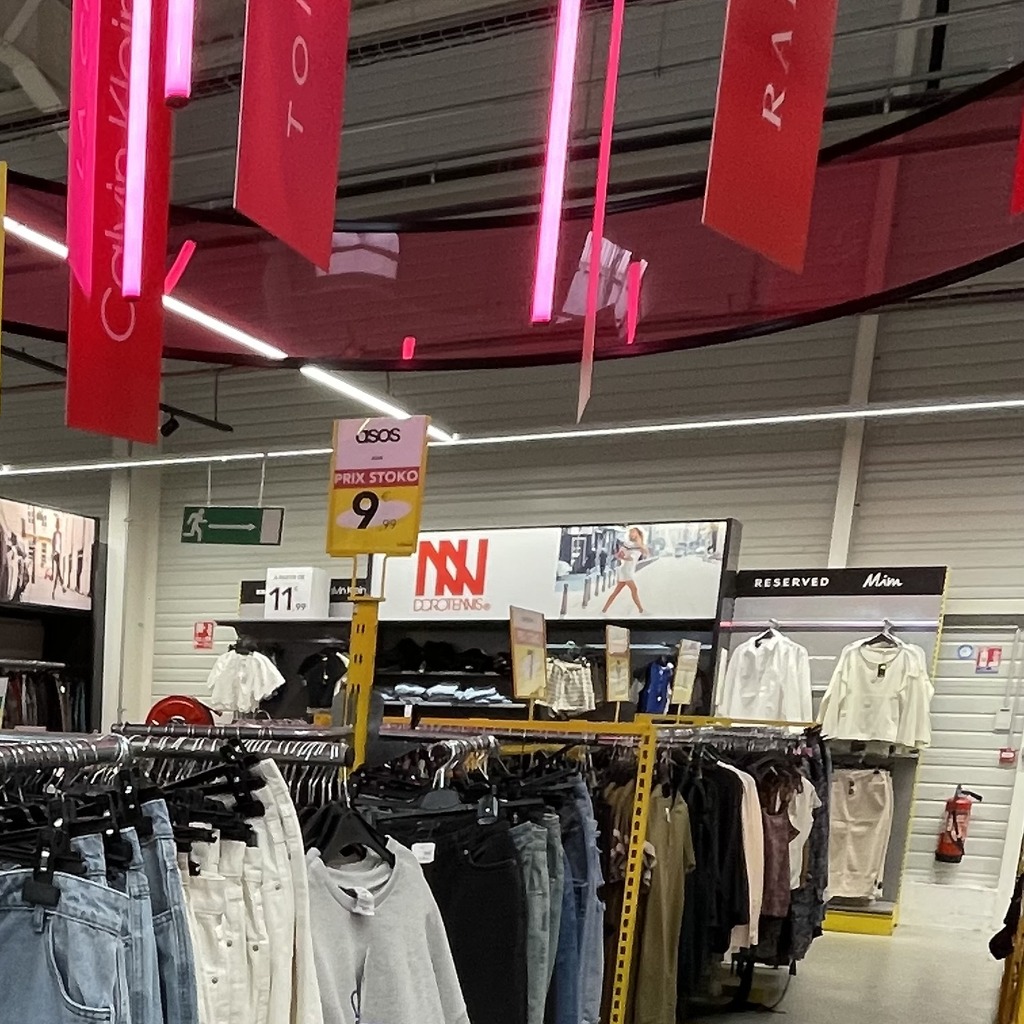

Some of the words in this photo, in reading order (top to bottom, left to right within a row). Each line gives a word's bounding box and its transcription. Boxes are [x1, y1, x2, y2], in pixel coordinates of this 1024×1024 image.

[356, 428, 401, 444] asos
[335, 472, 365, 485] PRIX
[369, 470, 419, 484] STOKO
[352, 491, 380, 530] 9
[754, 577, 830, 588] RESERVED
[862, 572, 904, 588] Mim
[269, 587, 293, 611] 11
